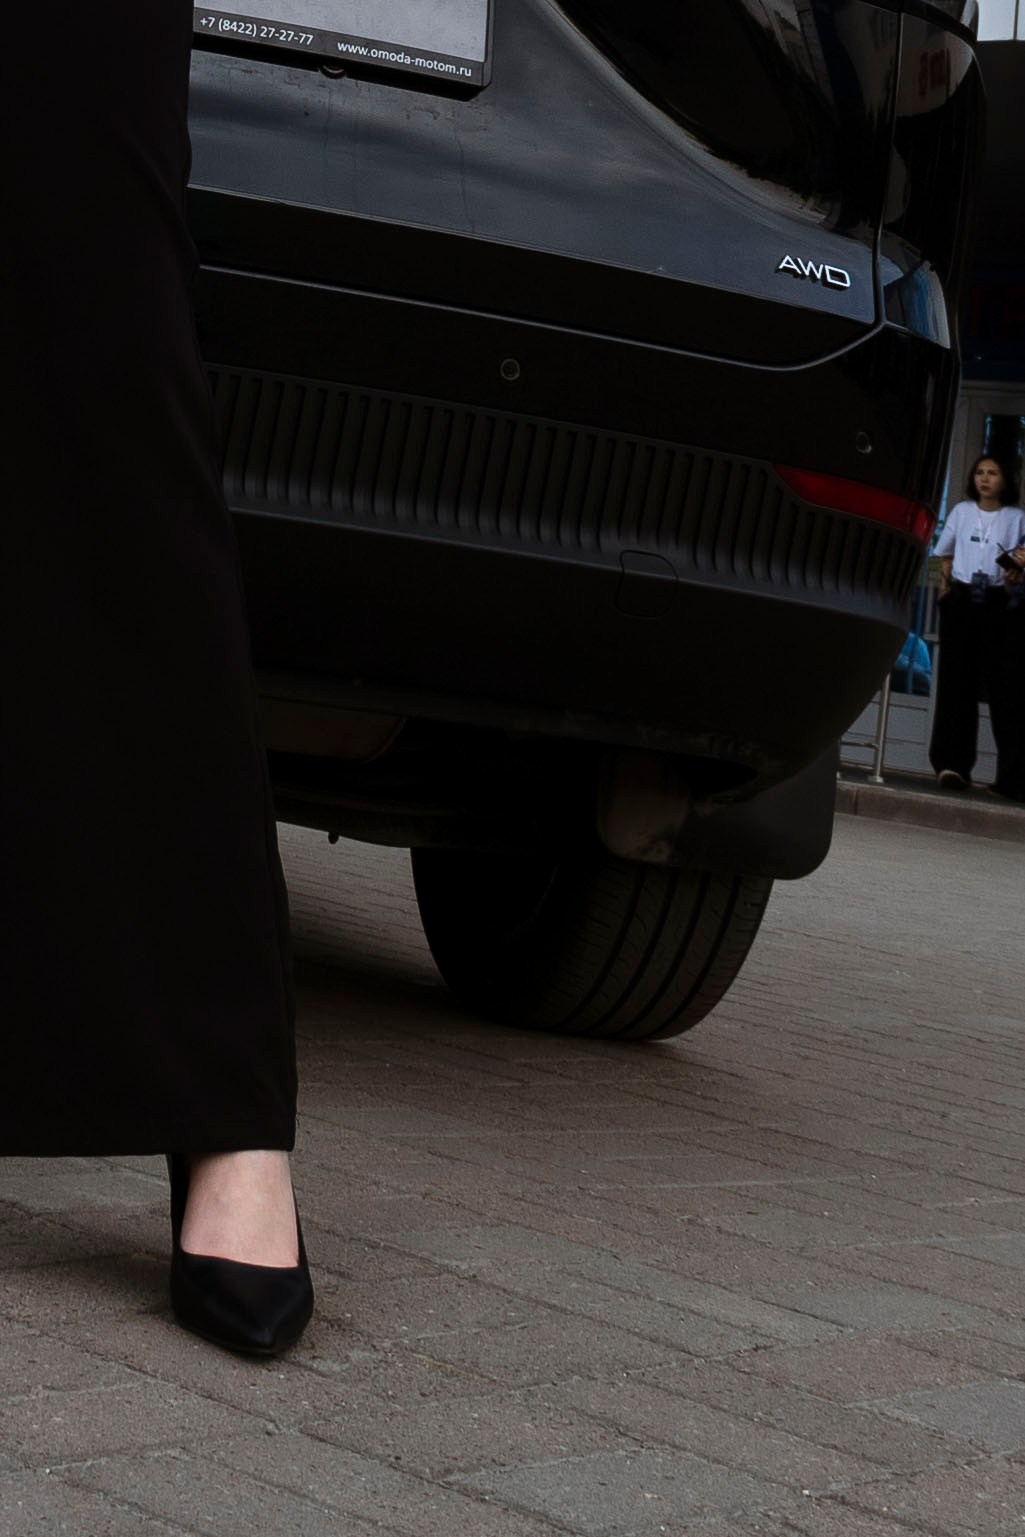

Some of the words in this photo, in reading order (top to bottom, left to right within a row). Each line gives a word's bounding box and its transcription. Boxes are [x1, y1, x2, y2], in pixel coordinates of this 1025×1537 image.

[200, 16, 216, 30] +7
[218, 17, 257, 37] (8422)
[260, 26, 314, 46] 27-27-77
[337, 40, 473, 78] www.omoda-motom.ru
[778, 255, 851, 288] AWD
